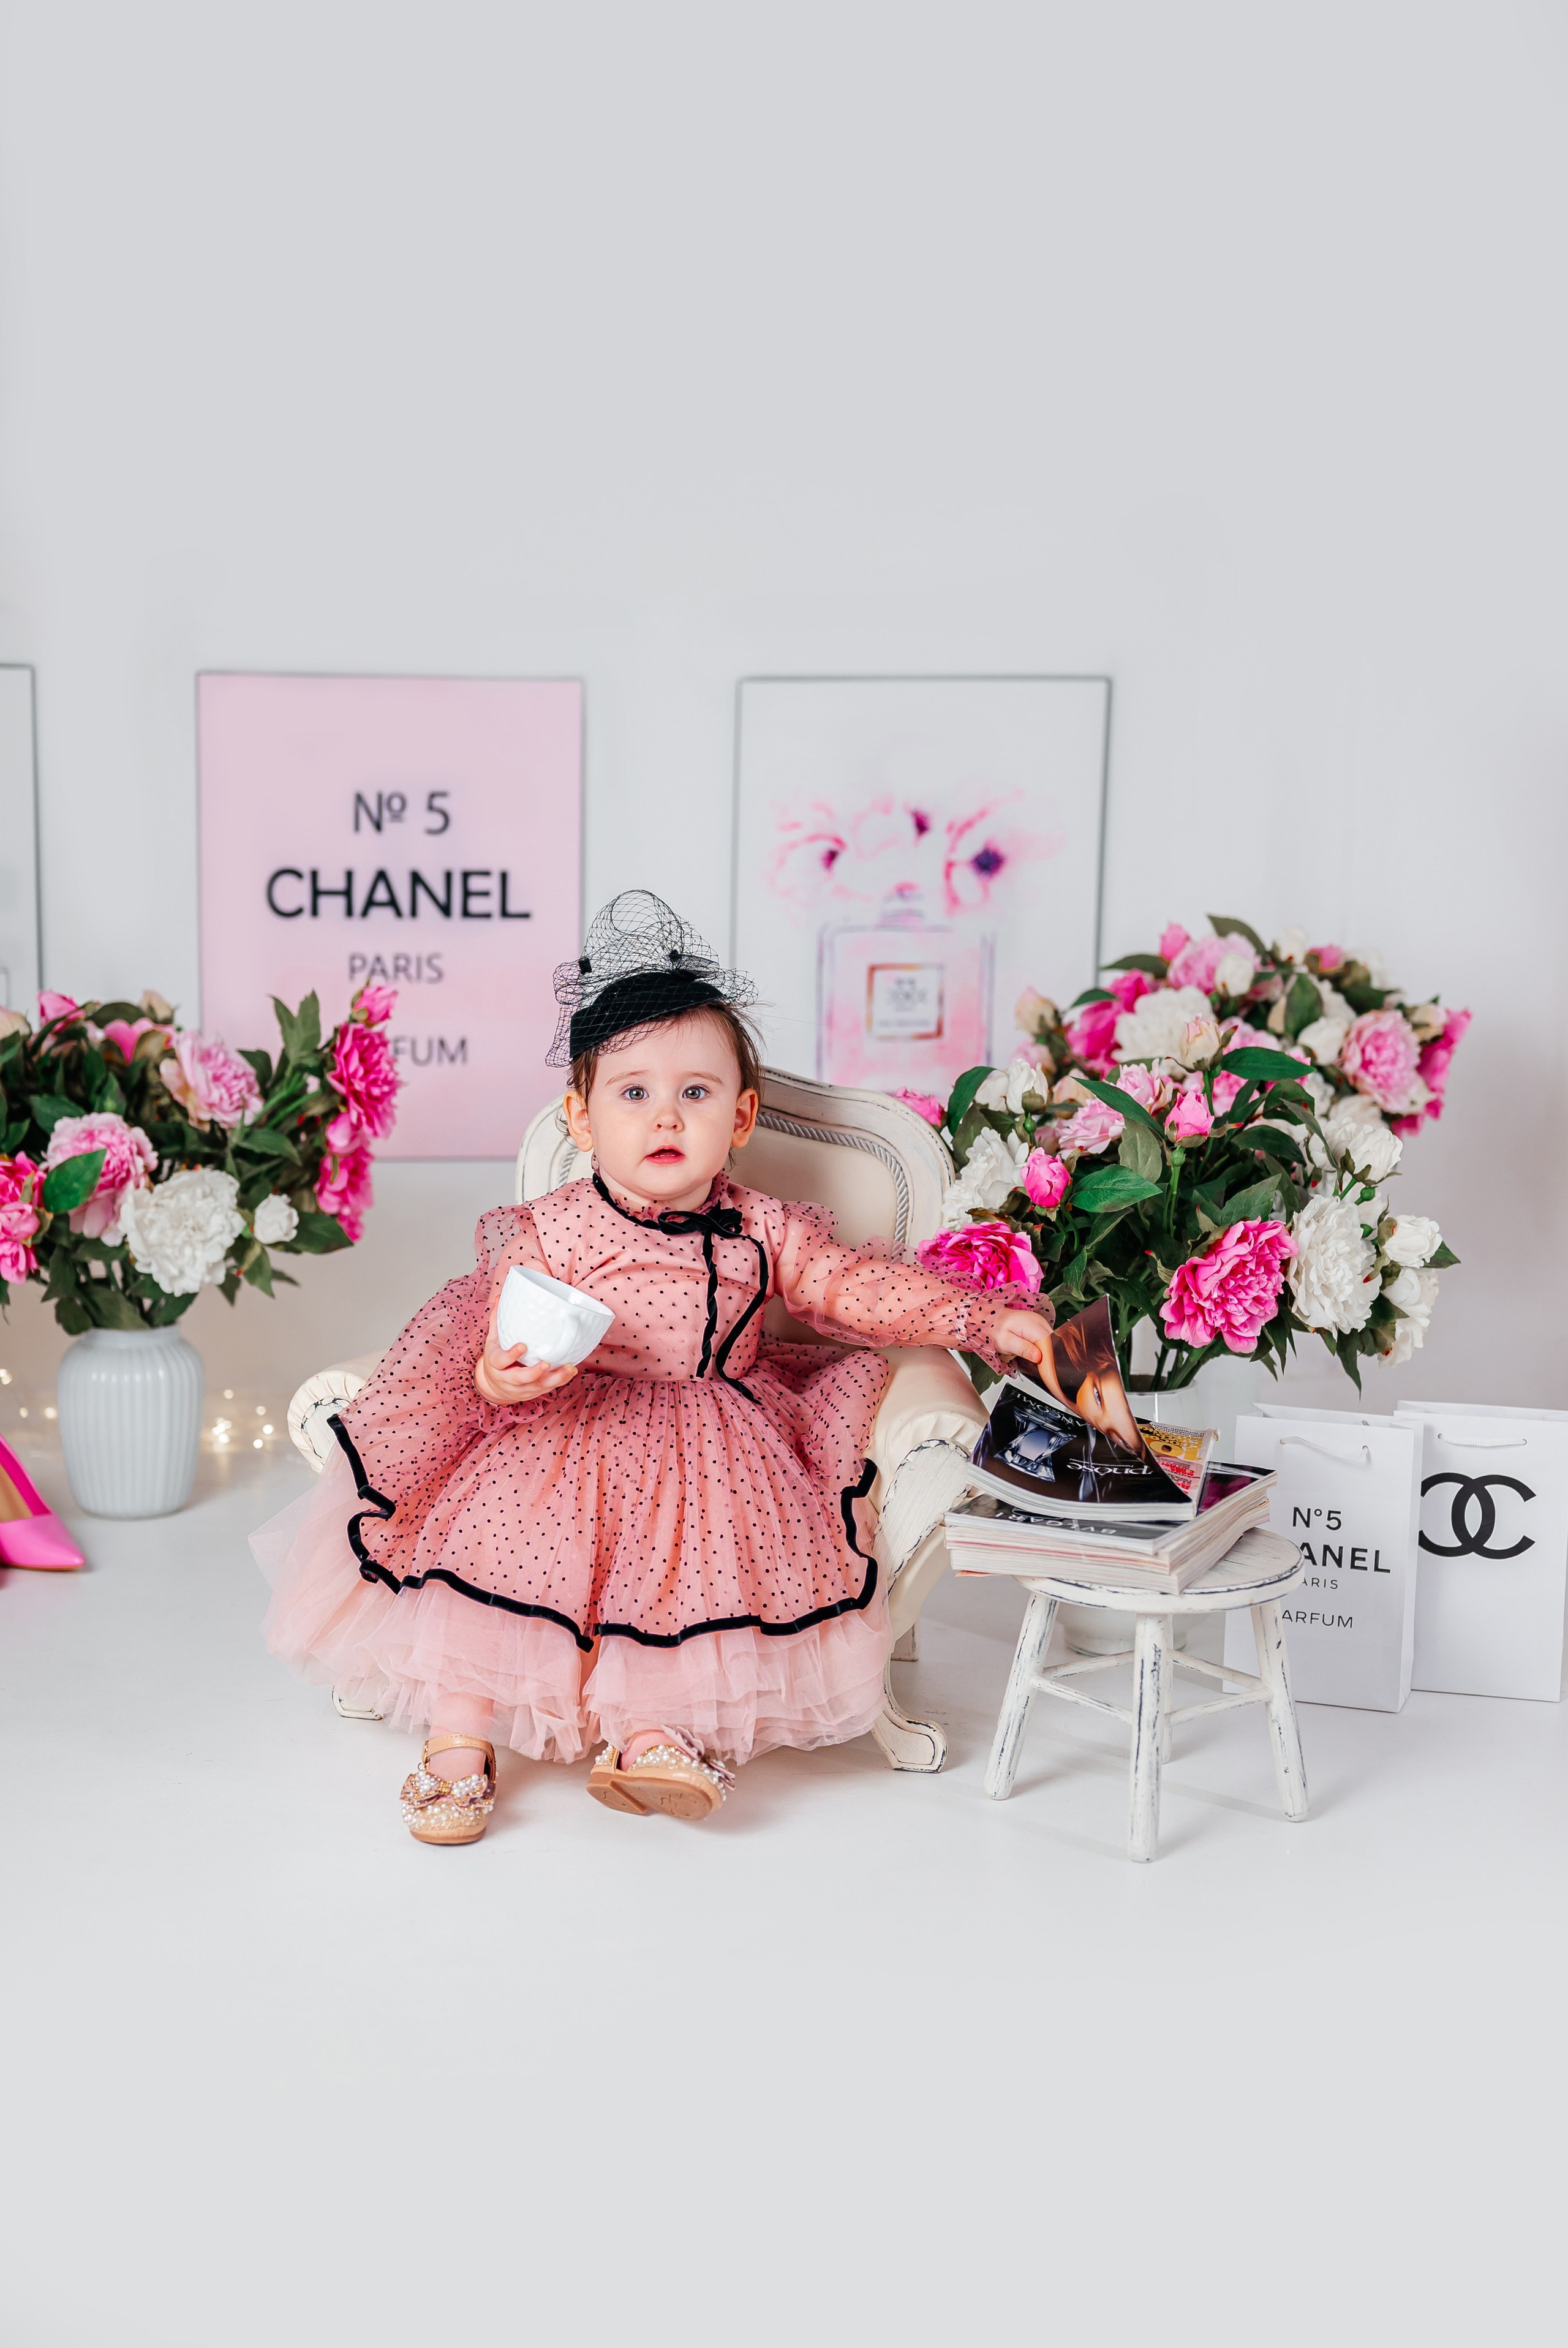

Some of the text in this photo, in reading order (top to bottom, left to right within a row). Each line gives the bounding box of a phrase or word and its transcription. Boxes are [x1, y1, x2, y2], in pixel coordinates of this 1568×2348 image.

[424, 791, 450, 836] 5
[266, 868, 532, 919] CHANEL
[349, 952, 444, 984] PARIS
[393, 1035, 469, 1066] FUM
[1299, 1542, 1391, 1574] ANEL
[1302, 1577, 1338, 1590] RIS
[1282, 1610, 1353, 1629] ARFUM
